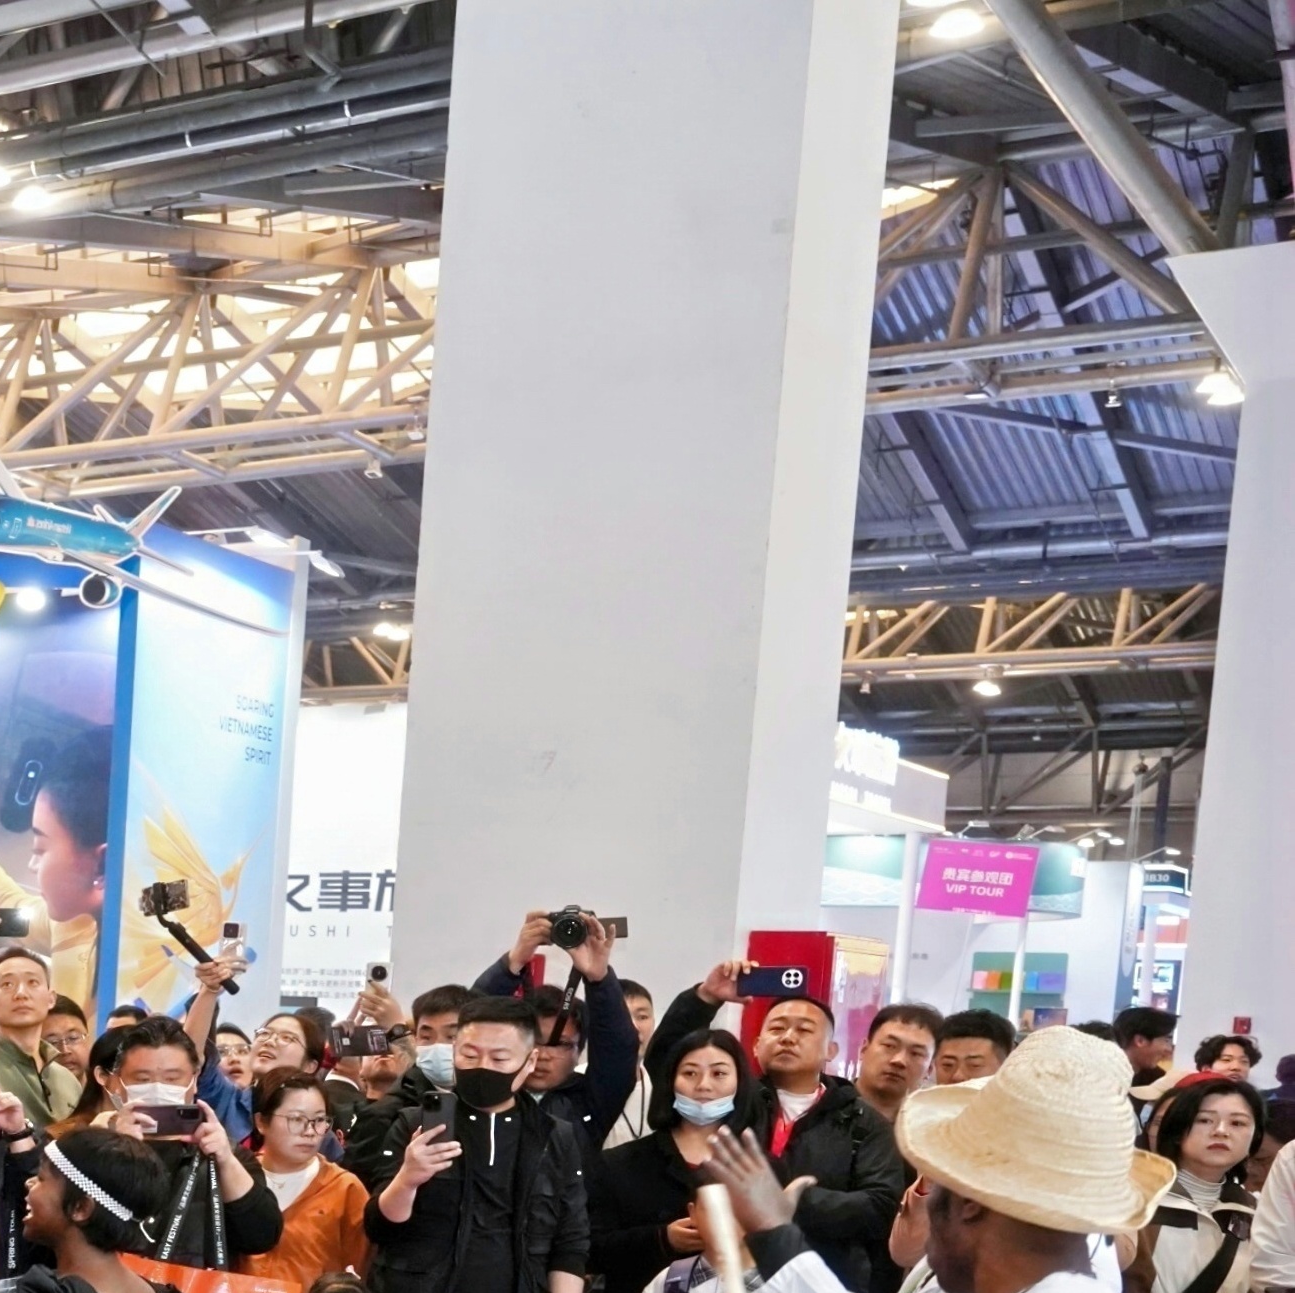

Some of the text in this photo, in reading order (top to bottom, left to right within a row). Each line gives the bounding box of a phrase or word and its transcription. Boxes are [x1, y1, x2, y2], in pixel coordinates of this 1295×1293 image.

[219, 715, 273, 742] VIETNAMESE
[244, 746, 272, 765] SPIRIT
[942, 867, 1014, 886] 贵宾参观团
[946, 883, 1004, 897] VIP TOUR
[167, 1214, 183, 1244] FESTIVAL
[8, 1237, 16, 1269] SPRING
